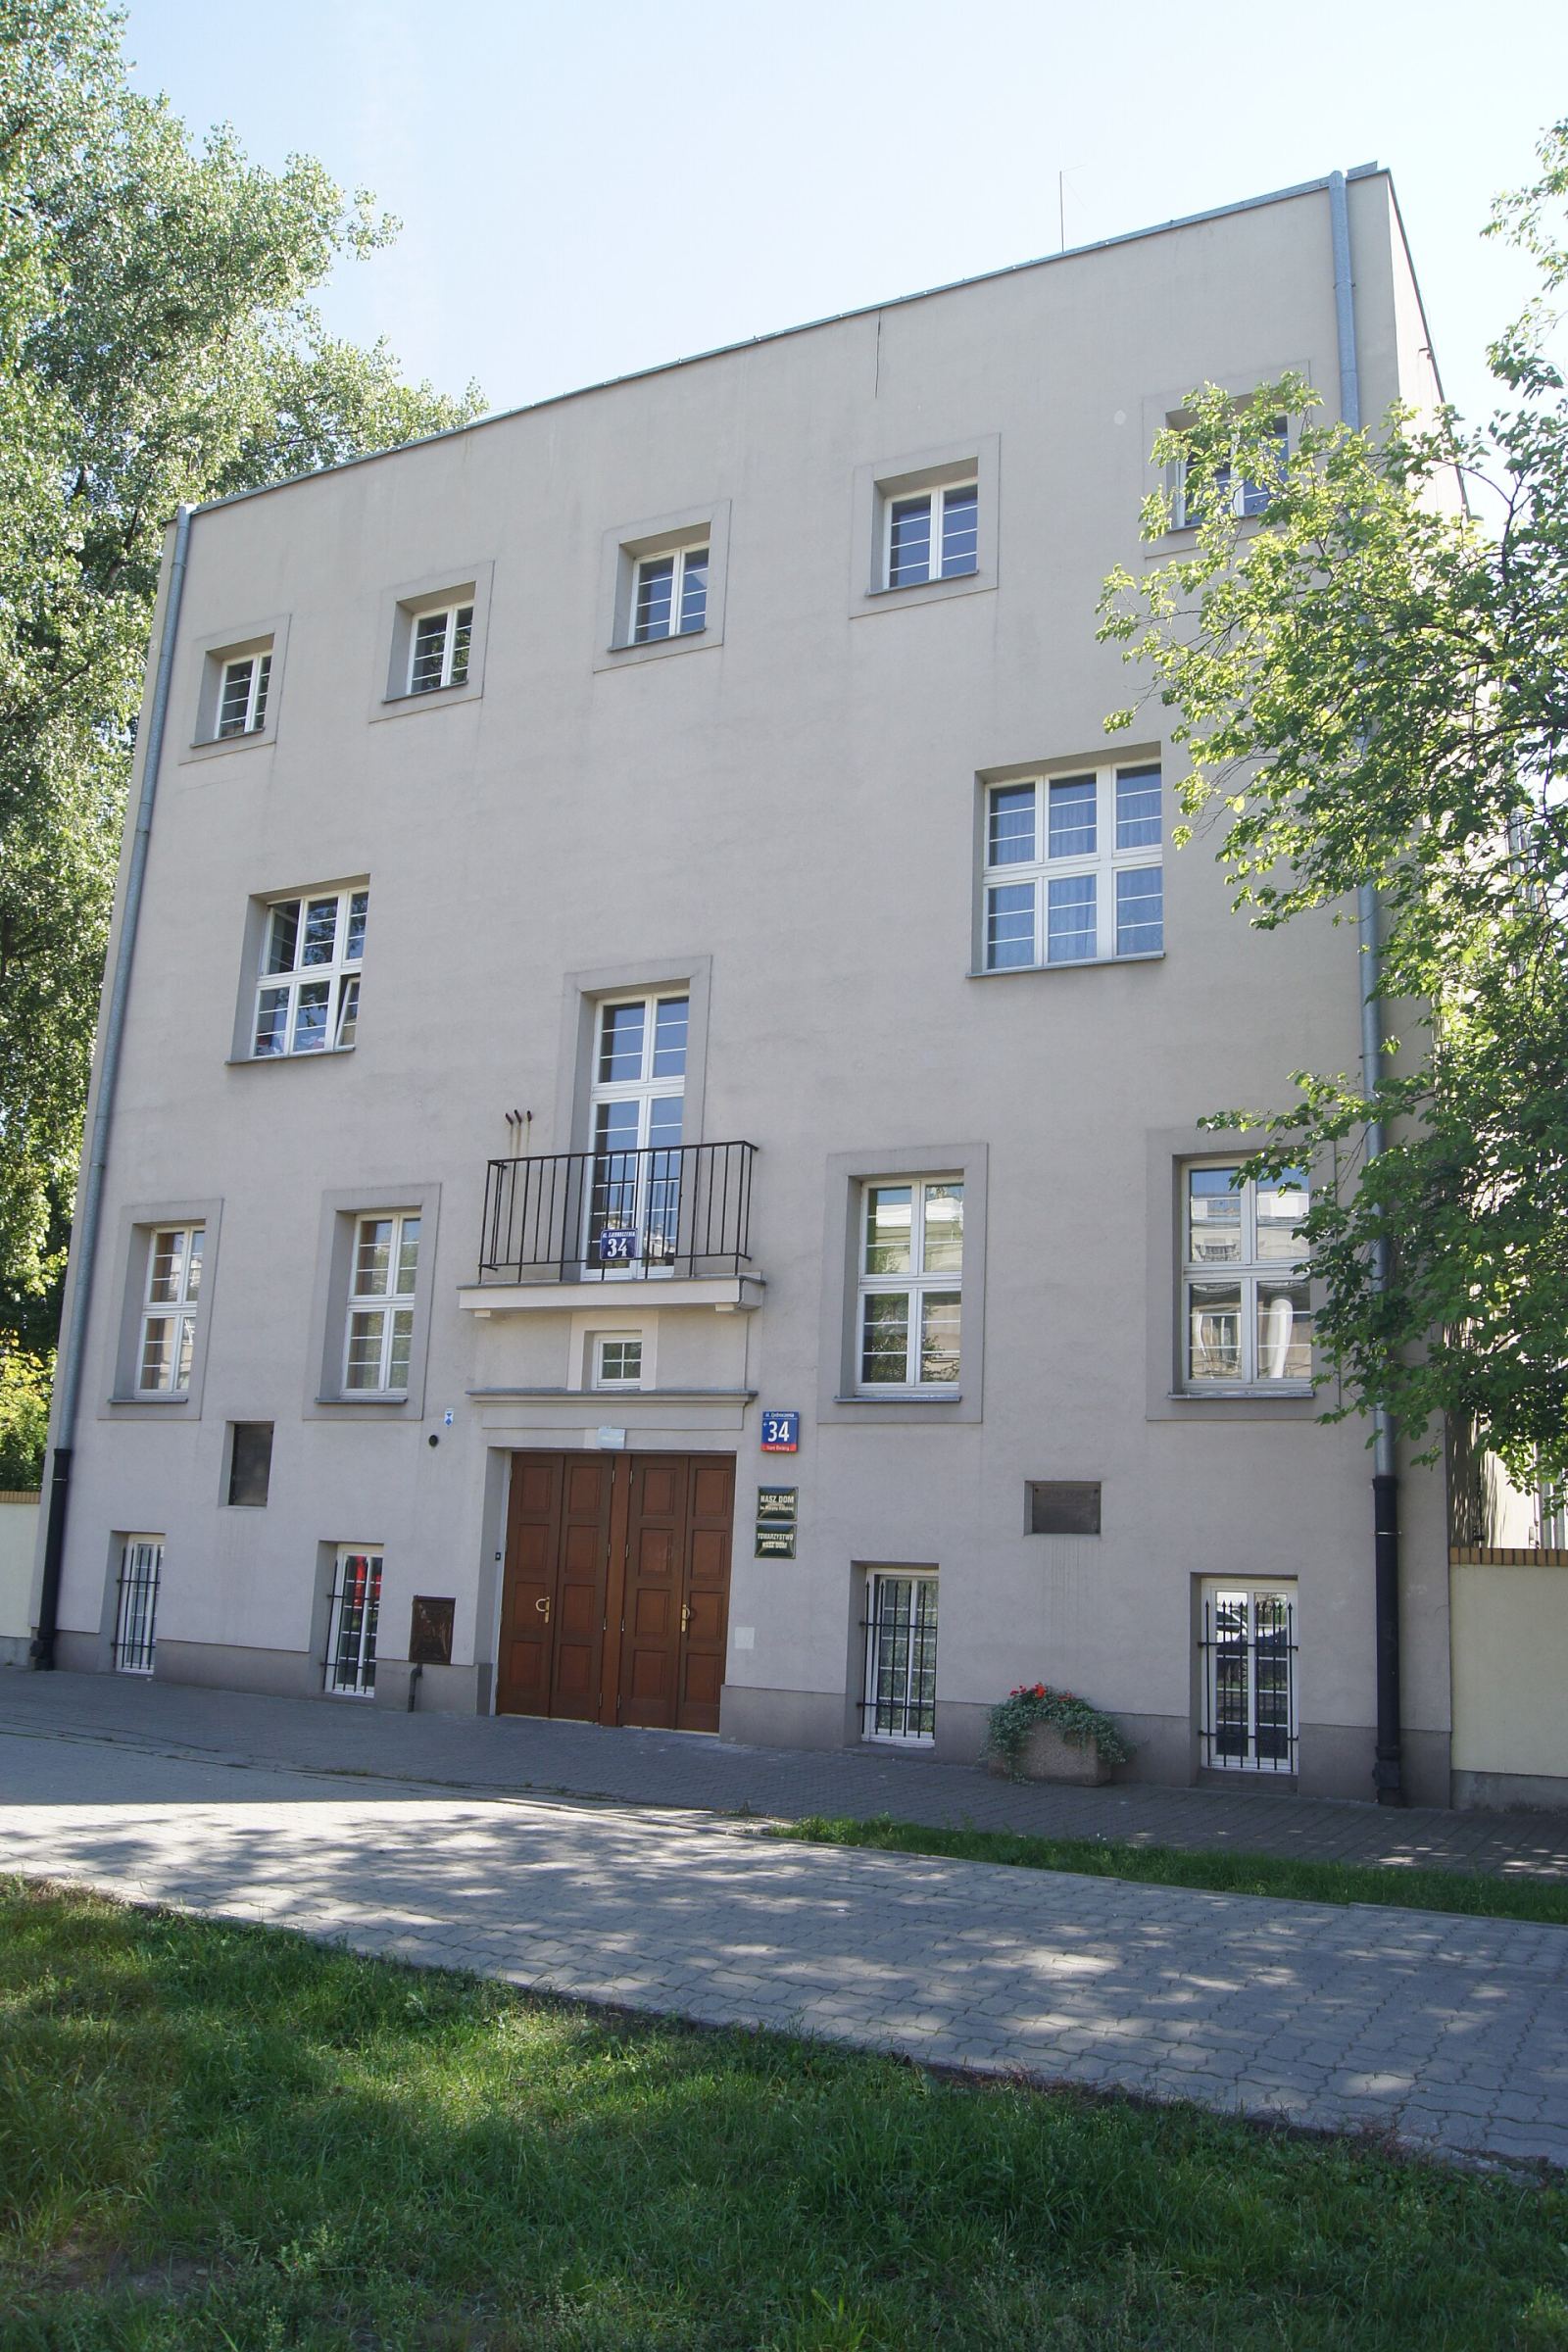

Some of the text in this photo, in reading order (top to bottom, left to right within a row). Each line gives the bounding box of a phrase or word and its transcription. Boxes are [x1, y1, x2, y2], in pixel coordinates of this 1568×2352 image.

[608, 1238, 627, 1257] 34
[767, 1420, 790, 1443] 34
[760, 1494, 795, 1504] NASZ DOM
